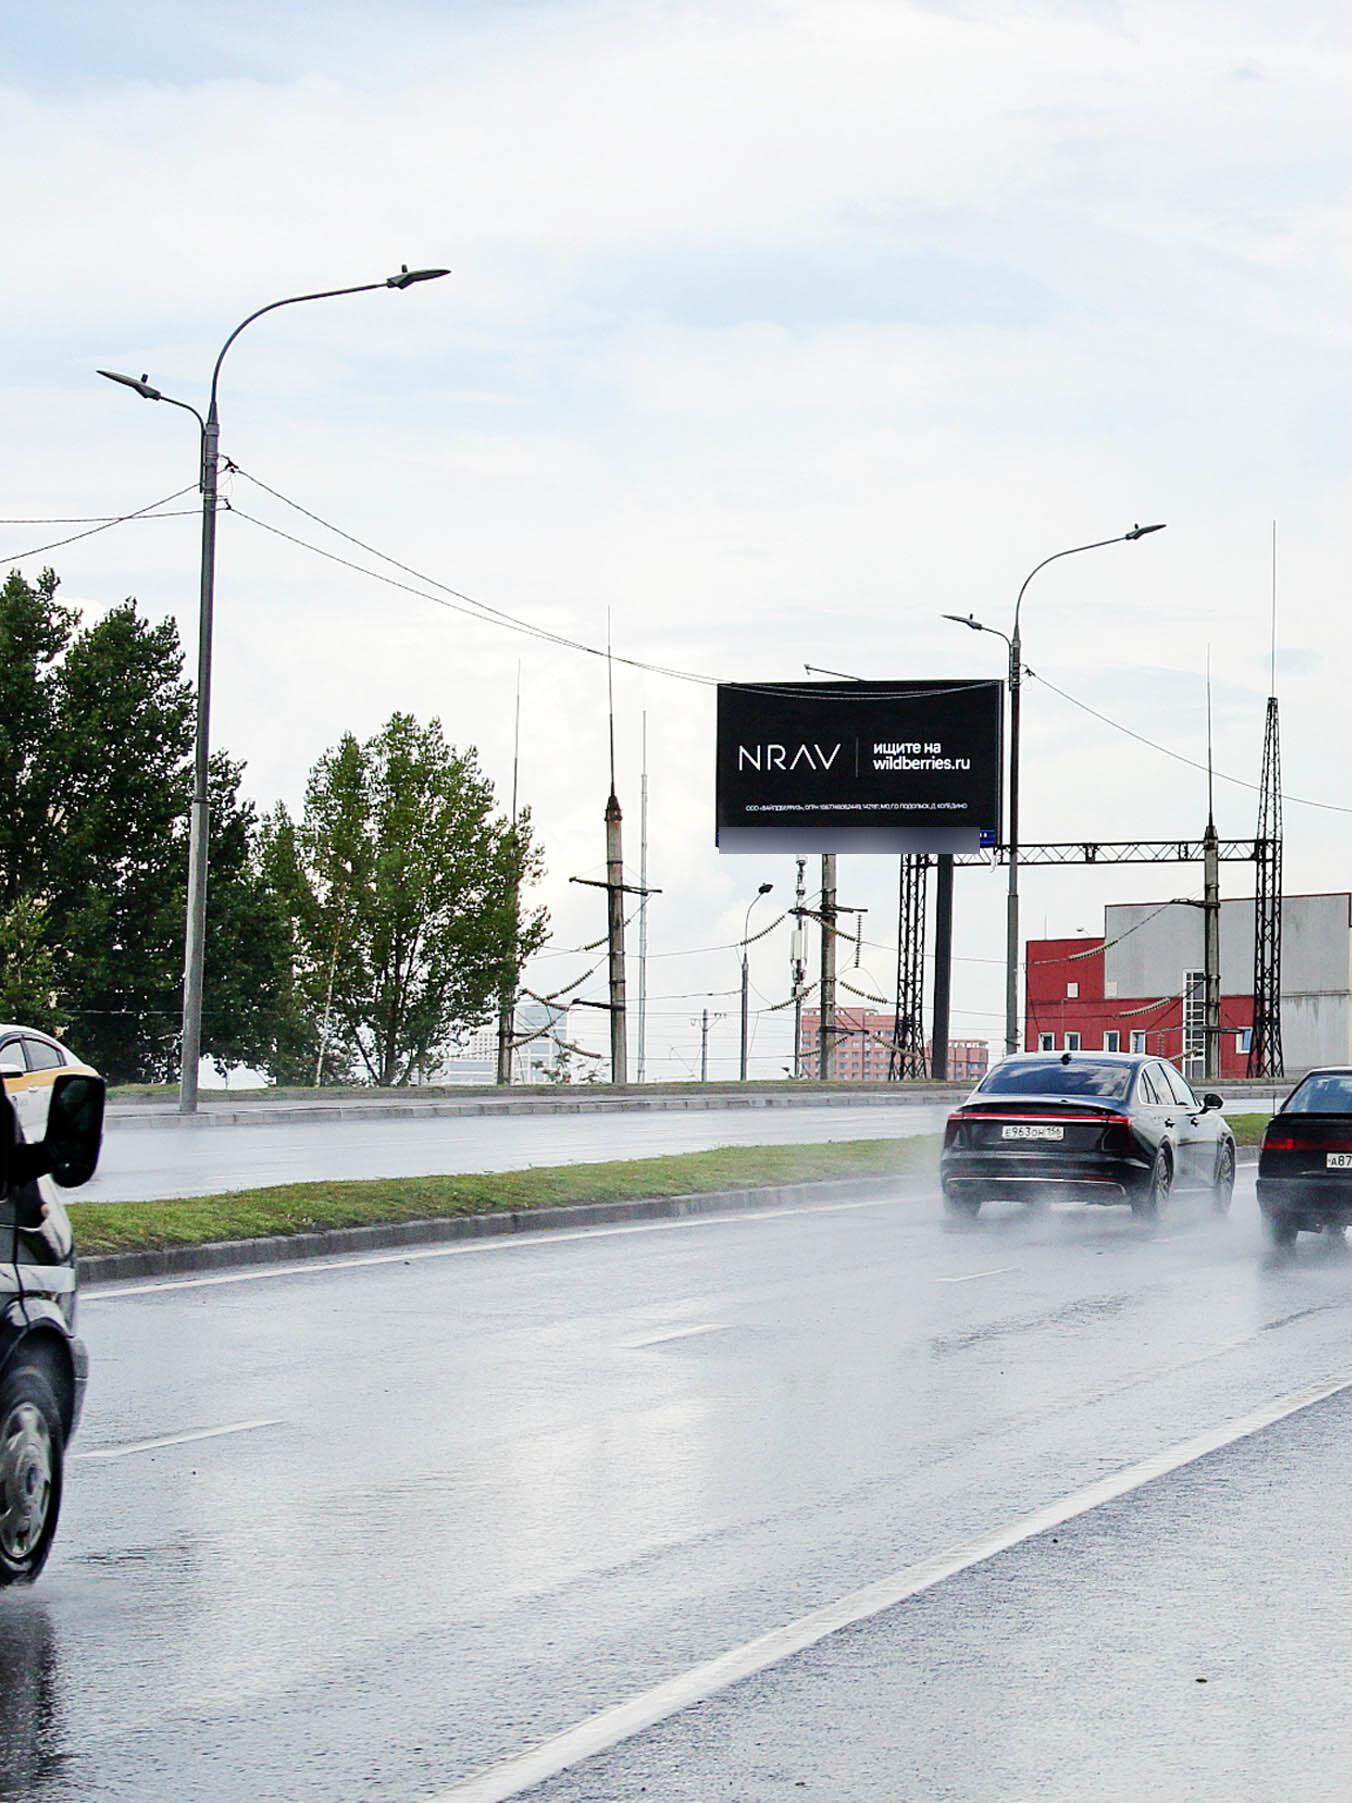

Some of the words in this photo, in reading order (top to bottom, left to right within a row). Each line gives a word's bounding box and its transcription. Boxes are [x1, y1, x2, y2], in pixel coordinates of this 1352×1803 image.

[873, 743, 921, 756] ищите
[924, 743, 942, 754] на
[738, 743, 841, 771] NRAV
[873, 756, 971, 770] wildberries.ru
